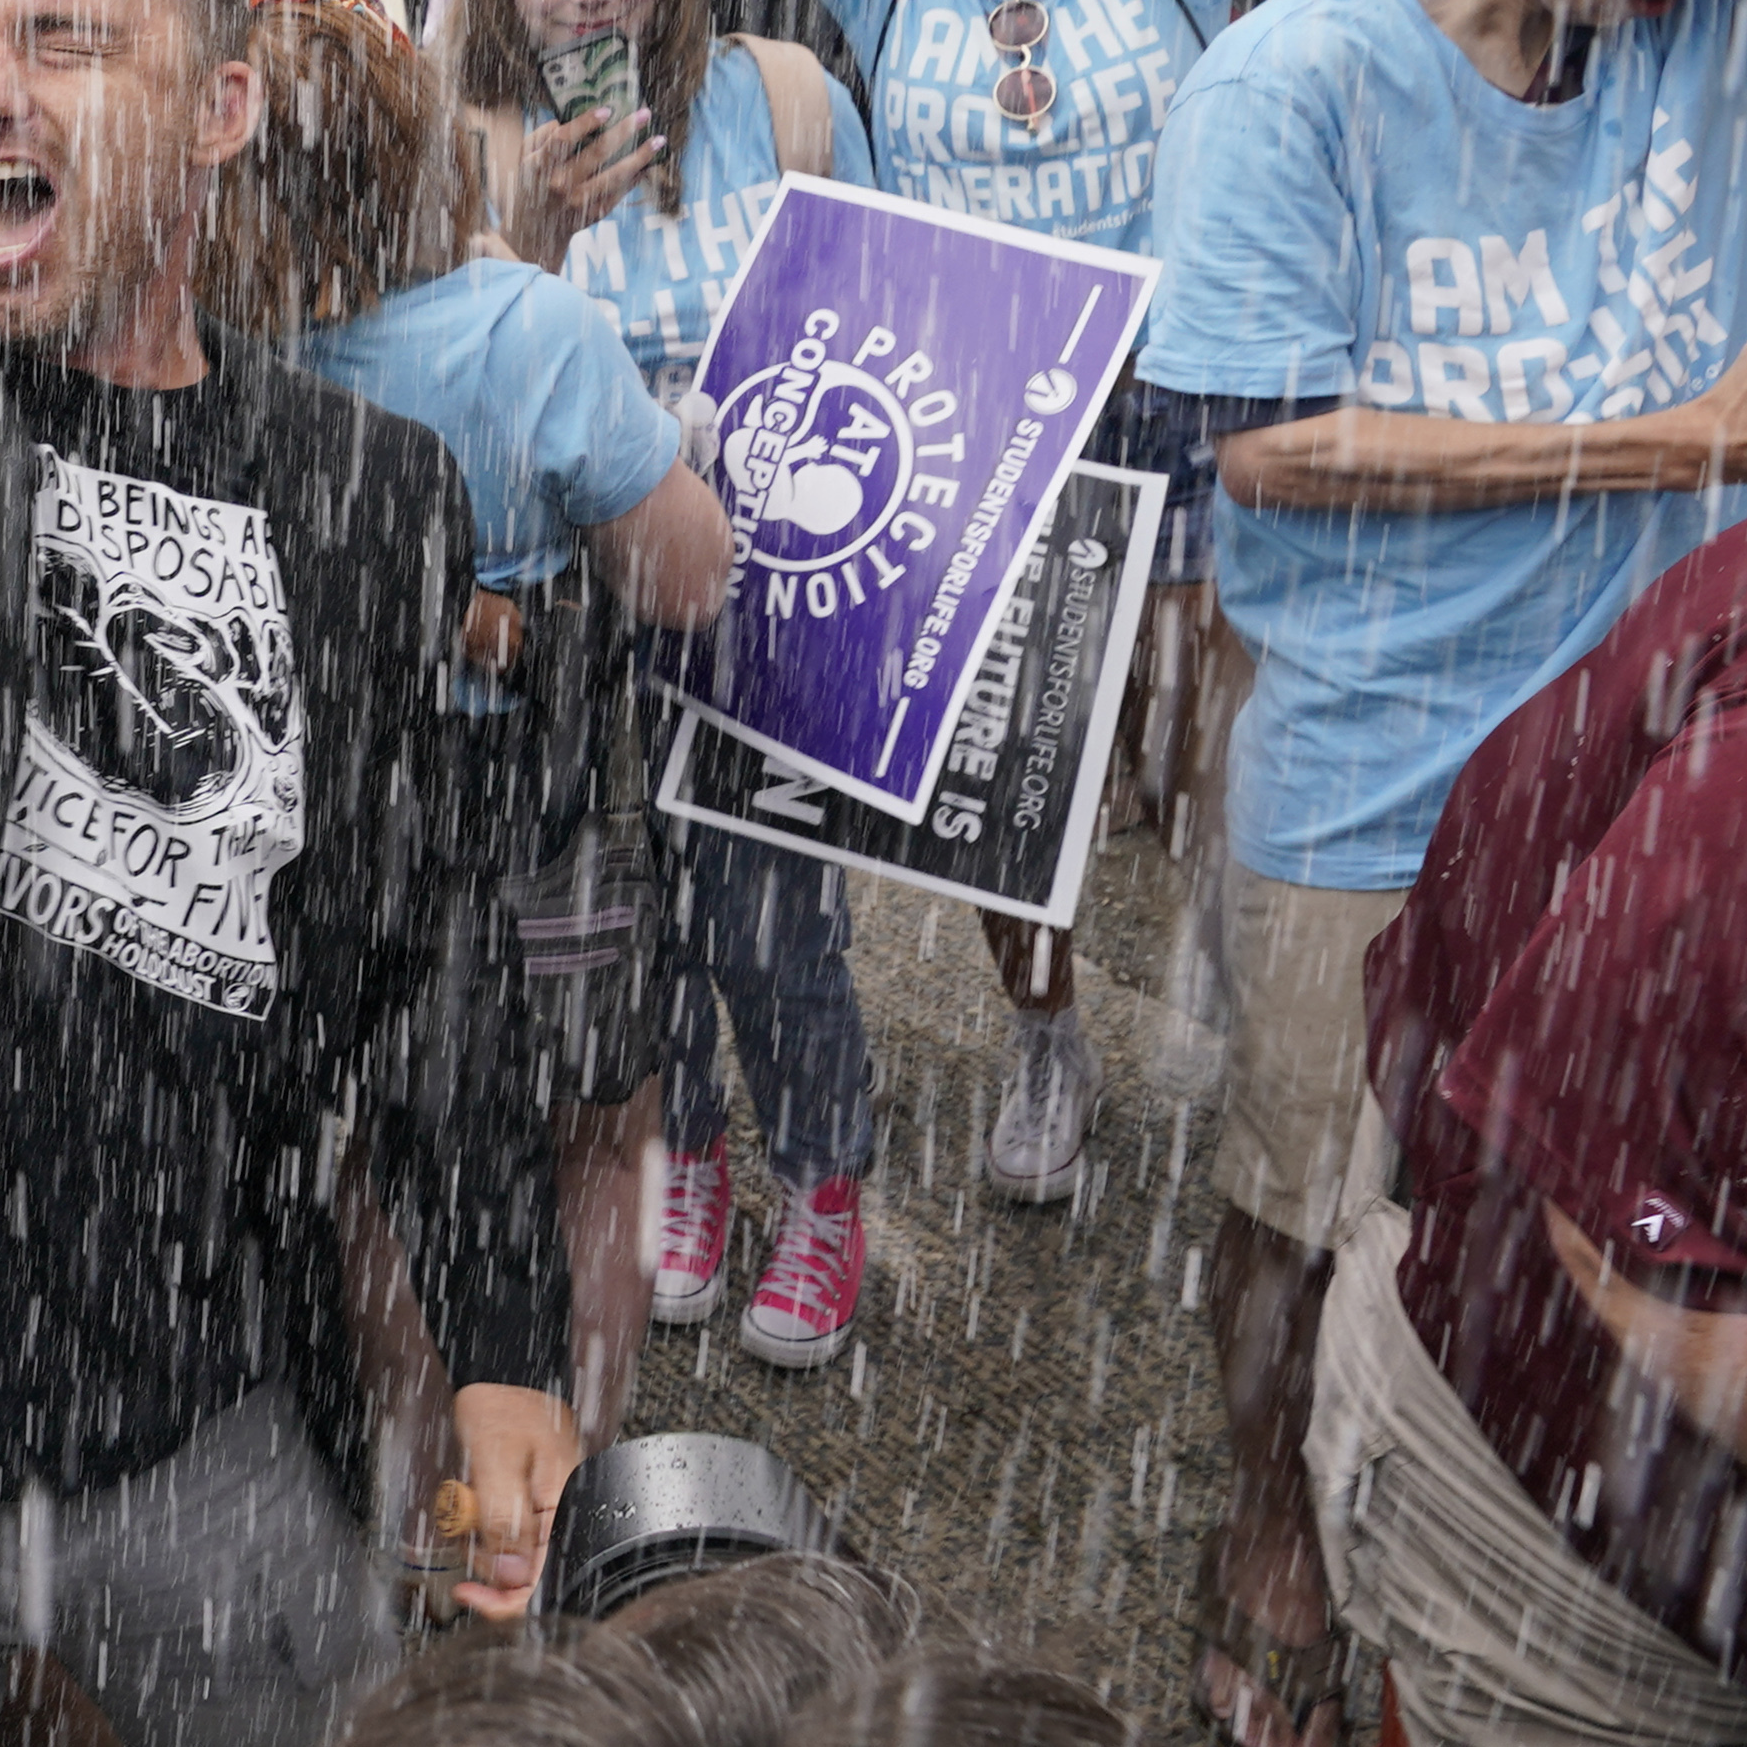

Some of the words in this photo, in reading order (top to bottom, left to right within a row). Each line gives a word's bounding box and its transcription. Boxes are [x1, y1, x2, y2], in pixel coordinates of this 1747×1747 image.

[1406, 228, 1571, 336] AM
[724, 308, 840, 601] CONCEPTION
[764, 324, 962, 621] PROTECTION
[831, 401, 892, 478] AT
[56, 499, 288, 614] DISPOSABL
[97, 479, 226, 546] BEINGS
[903, 417, 1044, 692] STUDENTSFORLIFE.ORG
[1012, 567, 1096, 831] STUDENTSFORLIFE.ORG
[209, 813, 266, 866] THE
[931, 790, 987, 845] IS
[167, 937, 278, 990] ABORTION
